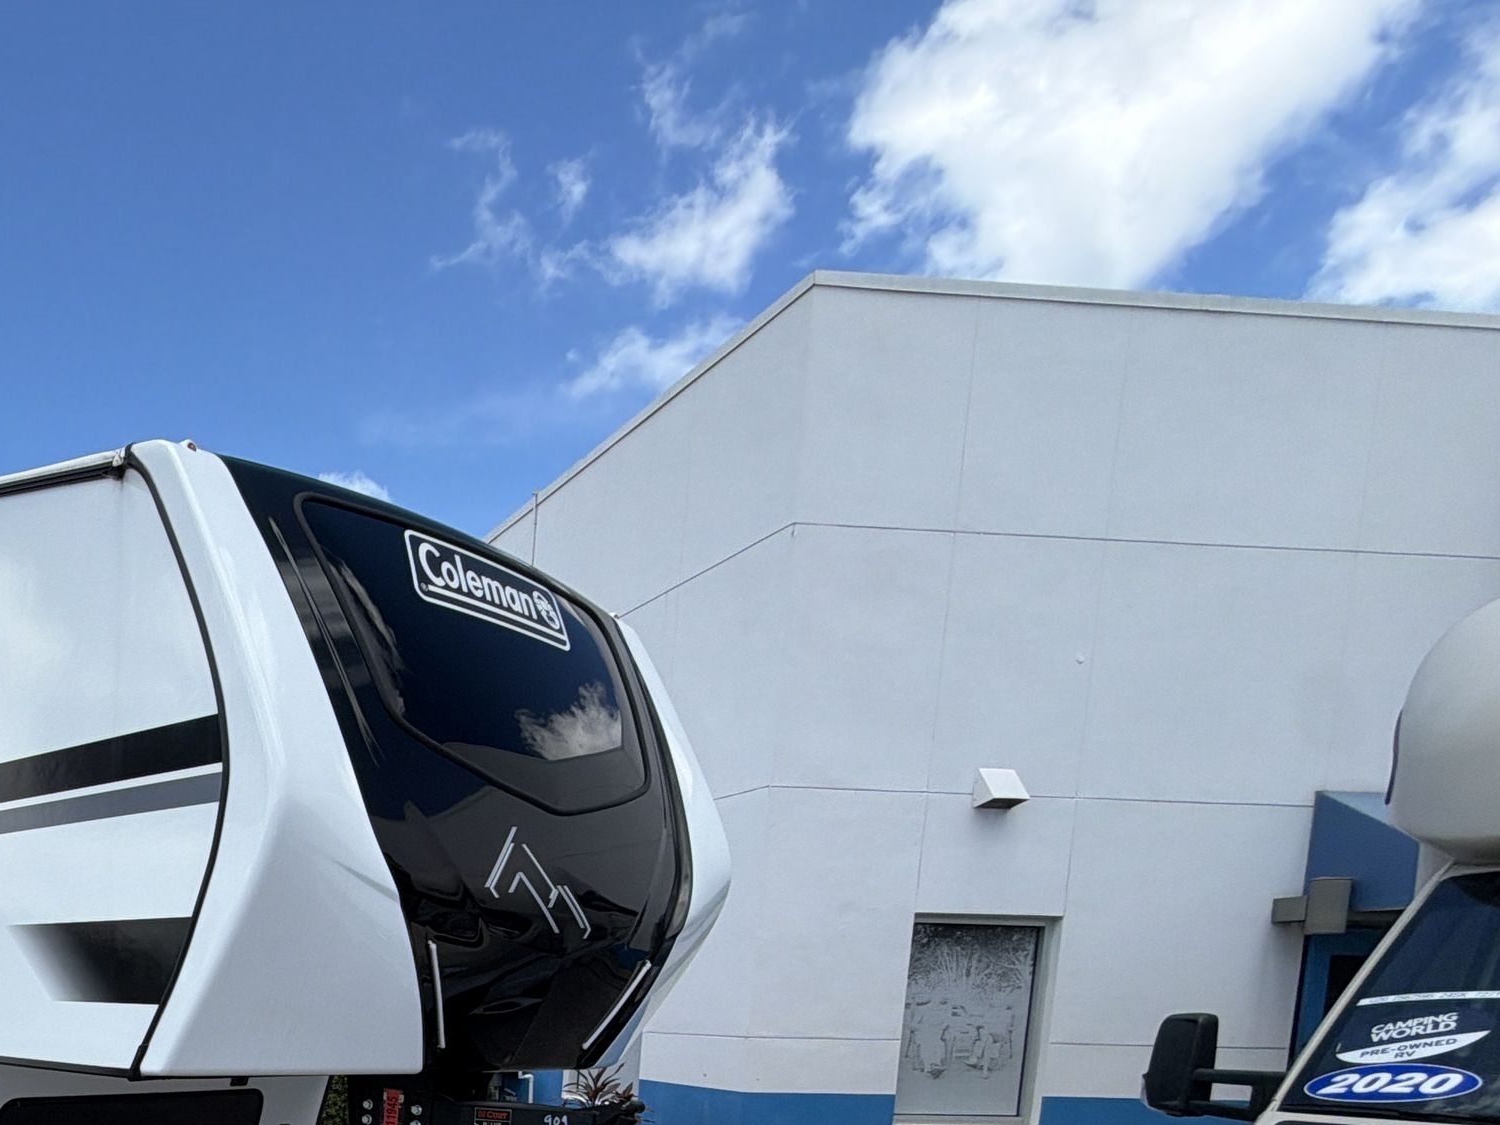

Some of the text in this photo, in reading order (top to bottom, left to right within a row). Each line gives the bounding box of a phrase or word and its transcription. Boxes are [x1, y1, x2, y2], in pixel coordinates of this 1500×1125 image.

[418, 542, 538, 620] Coleman
[1370, 1021, 1458, 1043] WORLD
[1371, 1011, 1459, 1034] CAMPING
[1359, 1038, 1458, 1059] PRE-OWNED
[1394, 1050, 1416, 1059] RV
[1315, 1072, 1464, 1095] 2020
[486, 1111, 508, 1119] CURT
